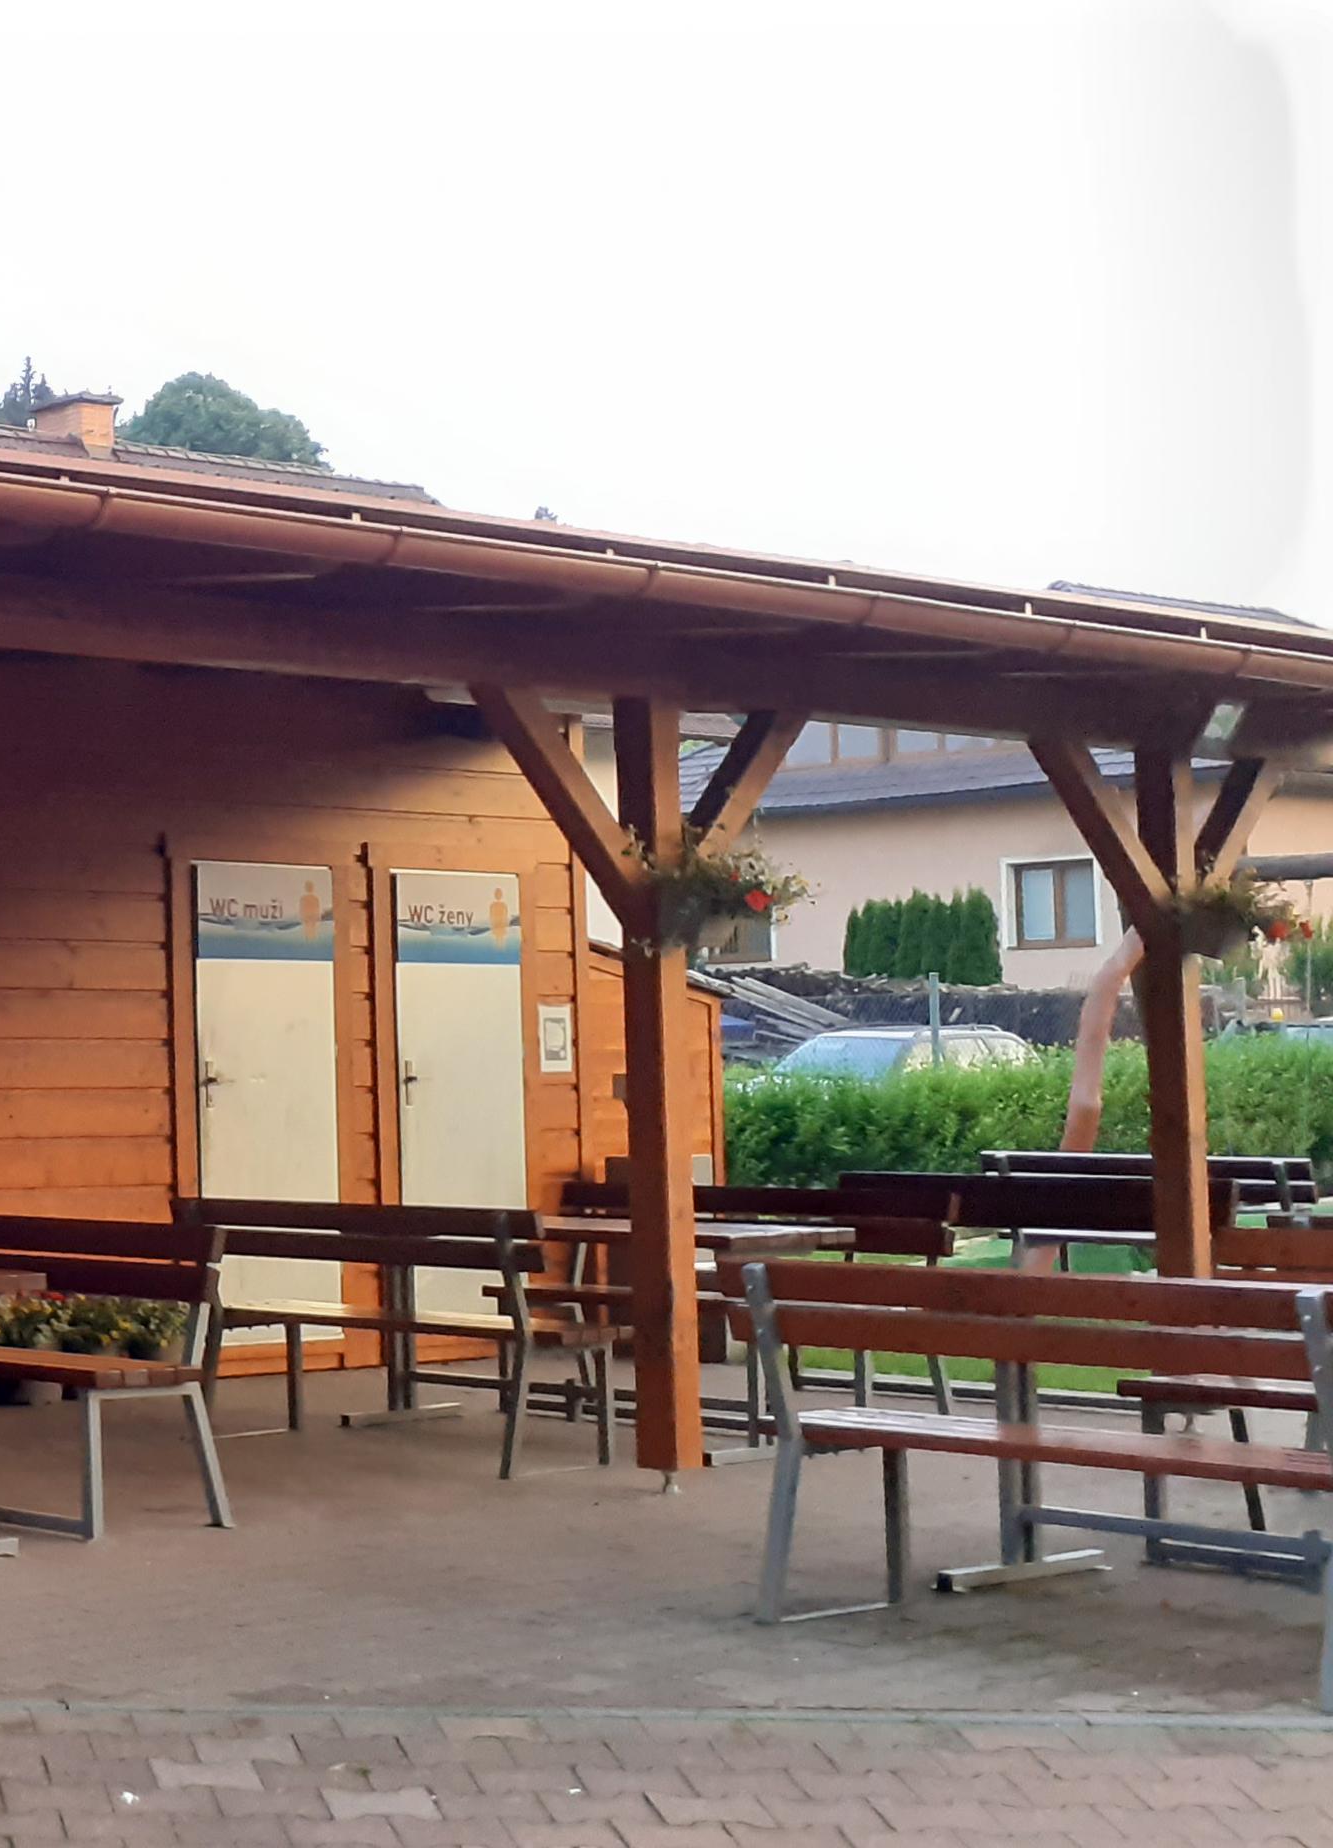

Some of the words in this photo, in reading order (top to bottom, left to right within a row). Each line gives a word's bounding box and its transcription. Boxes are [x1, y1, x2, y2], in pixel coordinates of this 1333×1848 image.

[209, 897, 238, 918] WC
[244, 898, 283, 920] muži
[408, 905, 434, 924] WC
[439, 905, 474, 926] ženy
